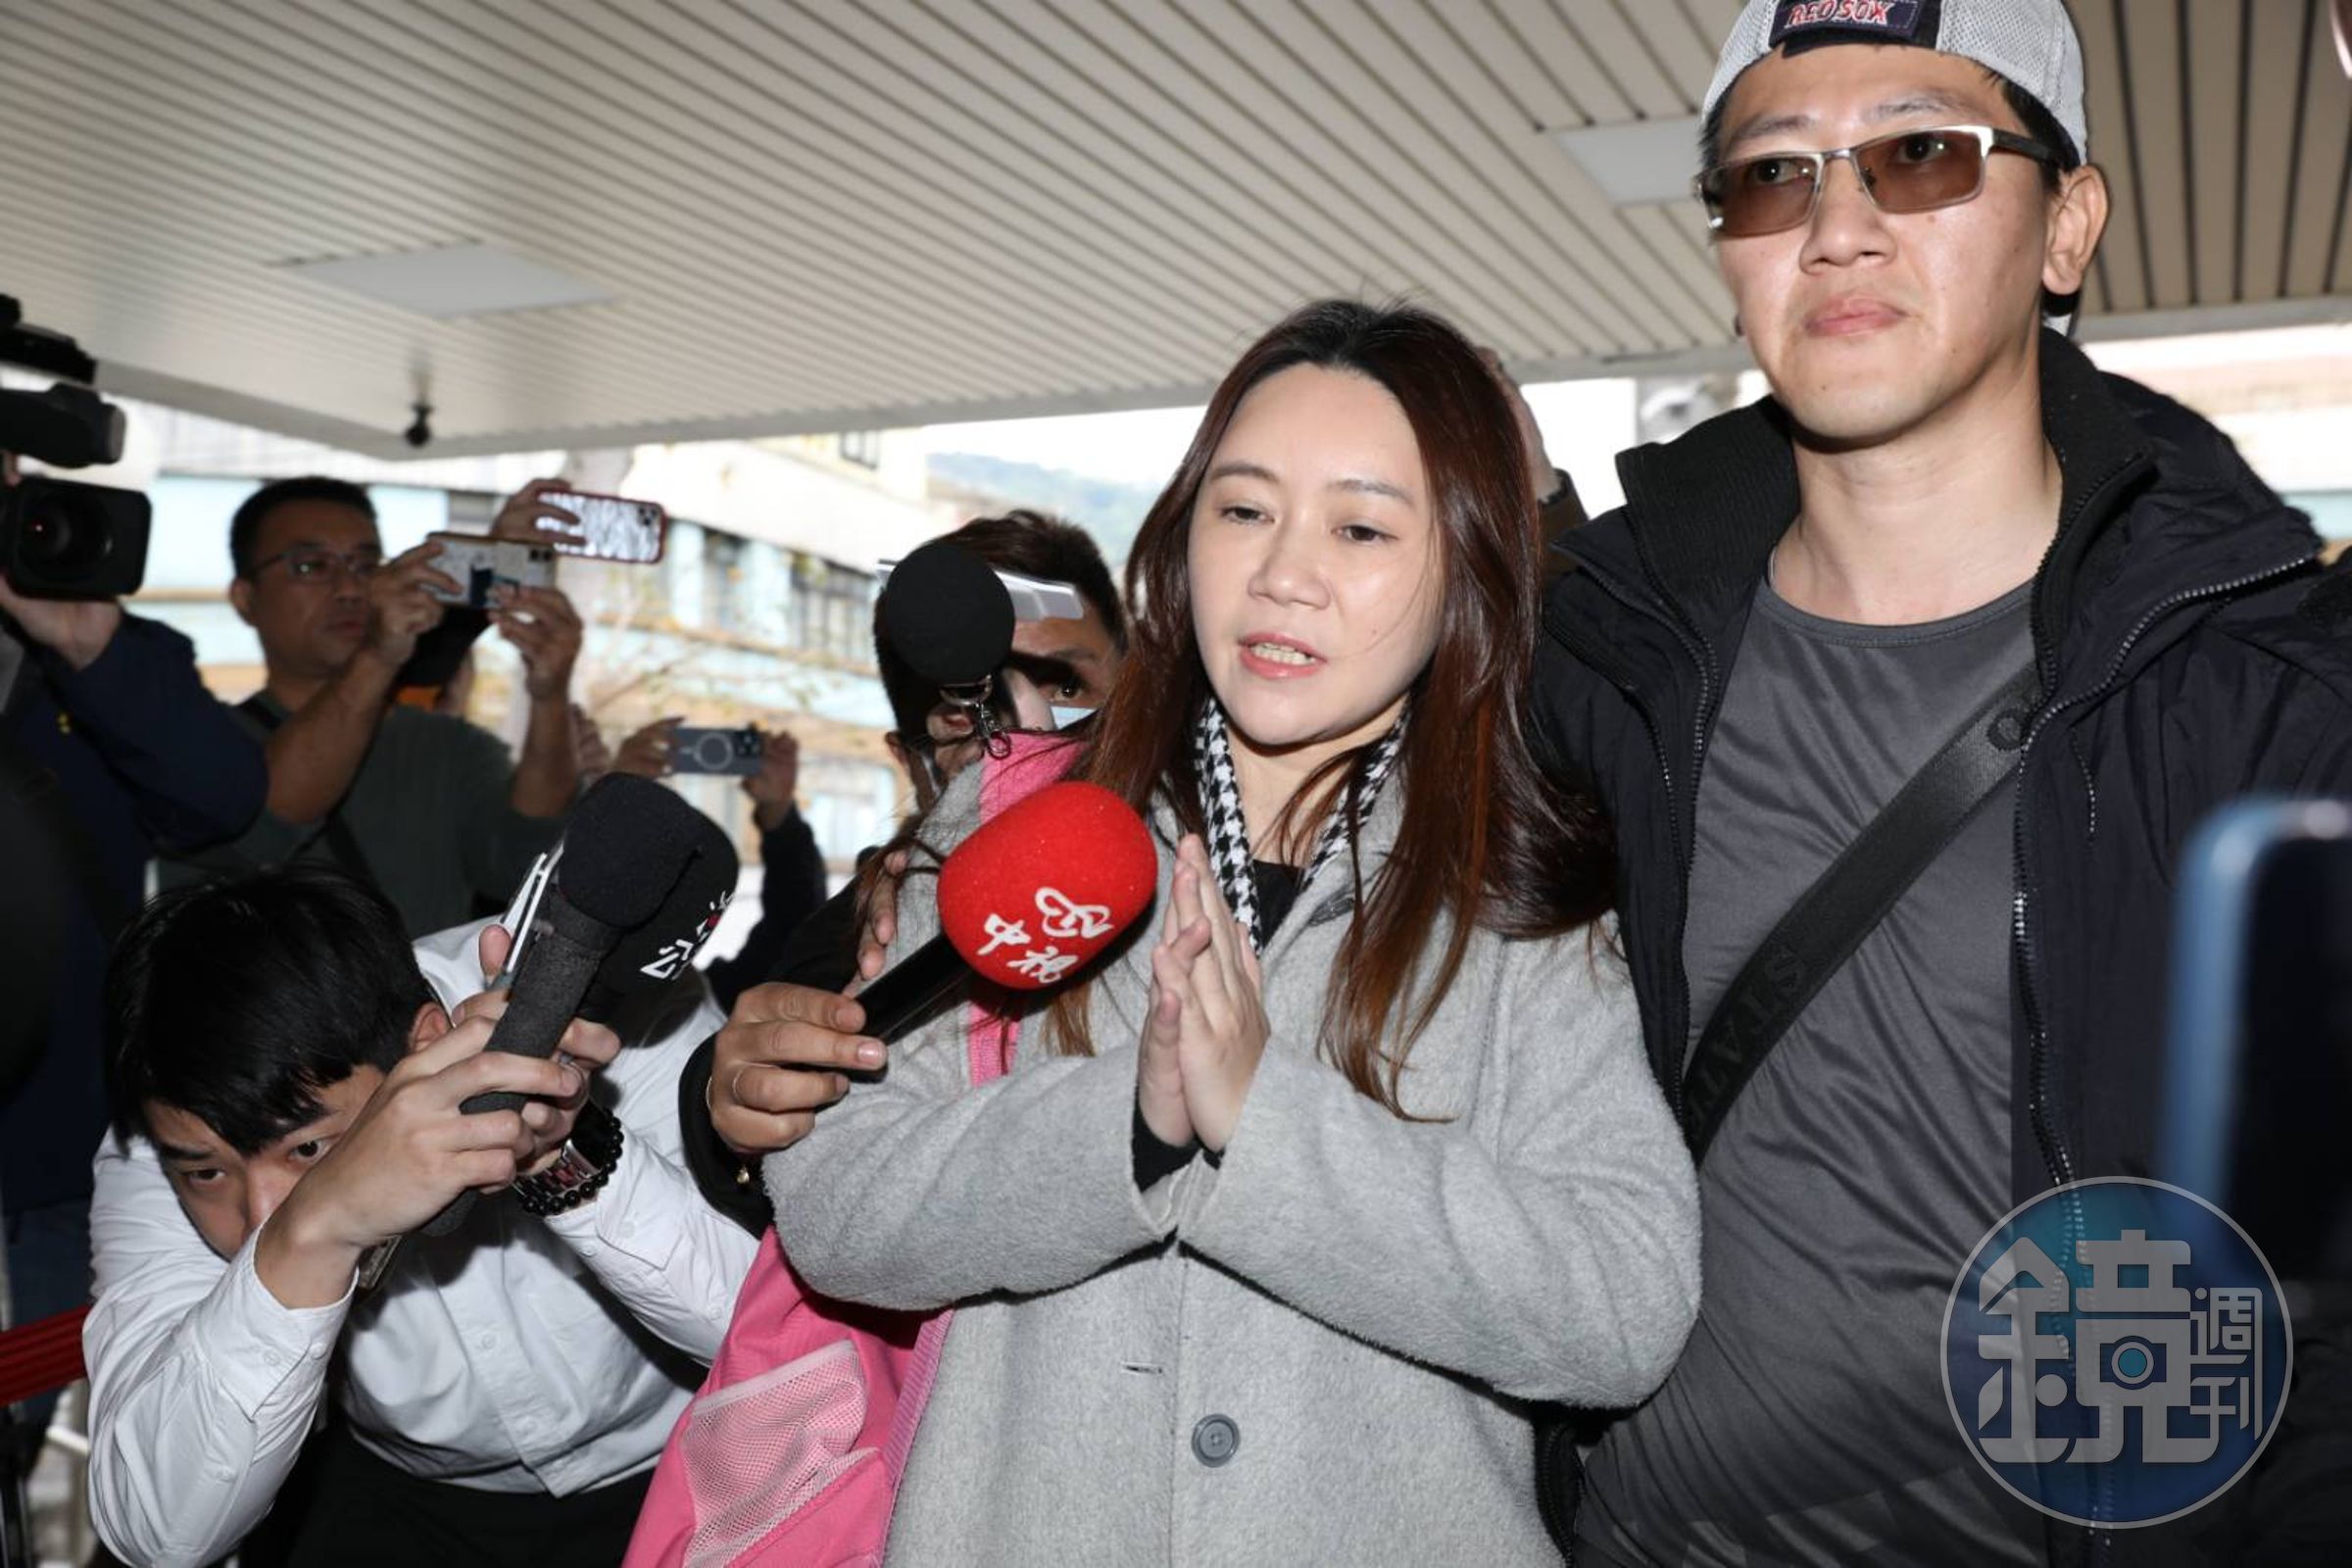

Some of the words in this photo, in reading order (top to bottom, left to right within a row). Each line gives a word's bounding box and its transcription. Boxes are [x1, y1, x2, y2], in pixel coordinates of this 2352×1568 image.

[1784, 0, 1835, 28] RED
[1833, 0, 1896, 25] SOX
[640, 939, 695, 980] 公
